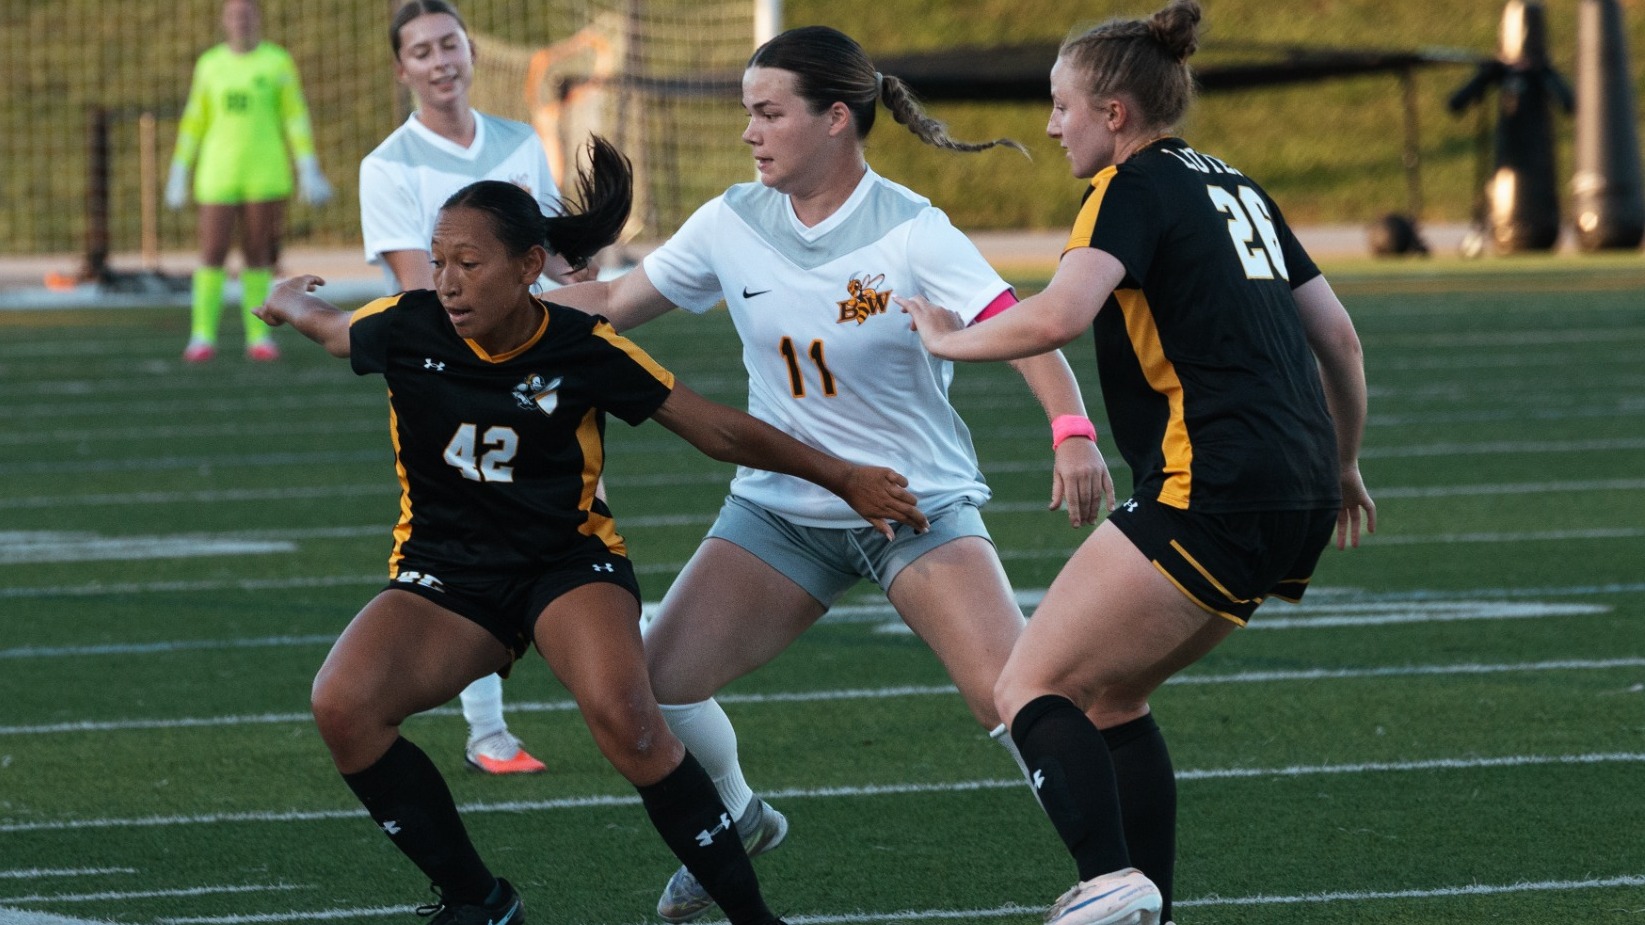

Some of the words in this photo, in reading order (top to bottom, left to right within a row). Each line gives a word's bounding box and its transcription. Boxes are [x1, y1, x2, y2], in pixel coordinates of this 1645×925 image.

[1206, 184, 1289, 282] 26
[779, 335, 837, 398] 11
[443, 422, 519, 483] 42
